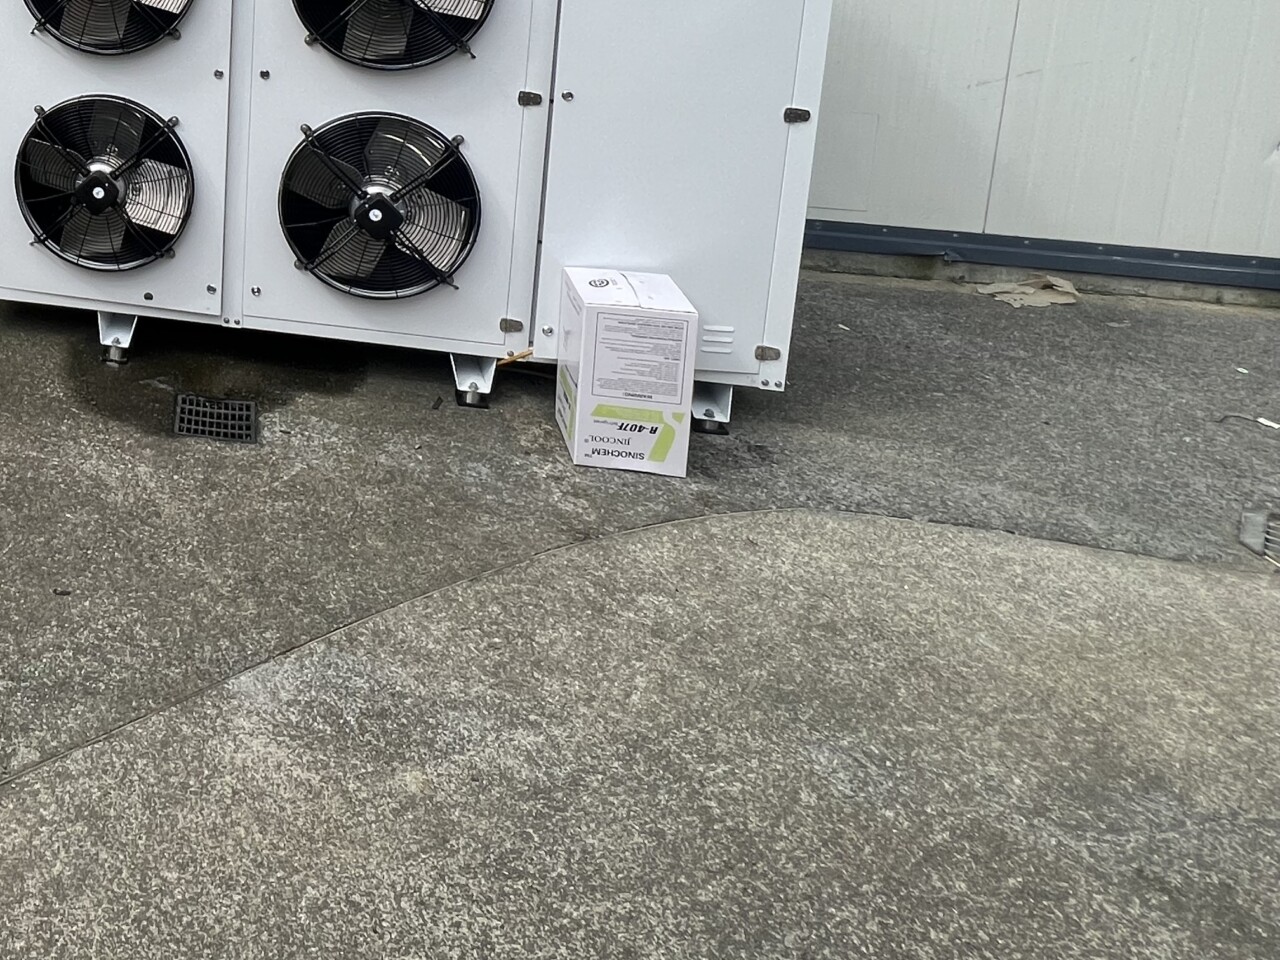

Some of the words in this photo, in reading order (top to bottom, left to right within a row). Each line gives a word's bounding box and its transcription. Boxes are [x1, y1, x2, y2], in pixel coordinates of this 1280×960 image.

[616, 422, 659, 435] R-407F
[588, 434, 631, 446] JINCOOL
[591, 447, 645, 460] SINOCHEM
